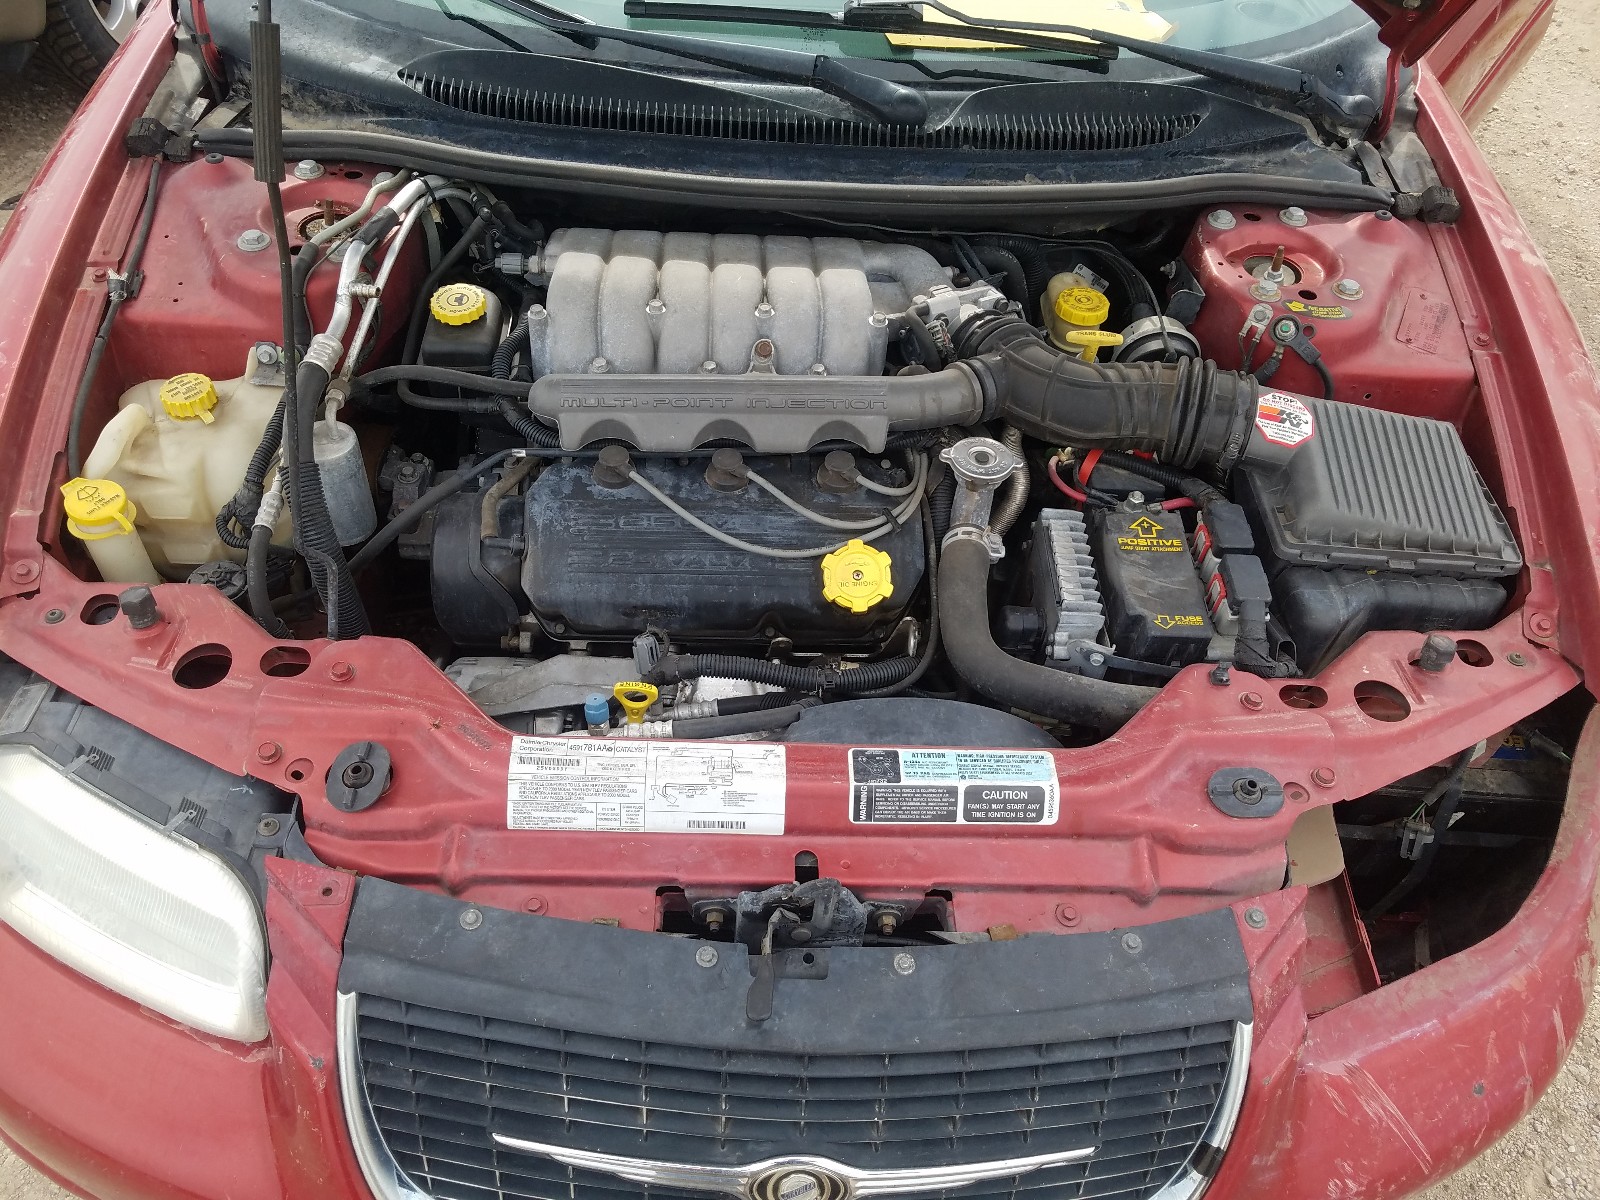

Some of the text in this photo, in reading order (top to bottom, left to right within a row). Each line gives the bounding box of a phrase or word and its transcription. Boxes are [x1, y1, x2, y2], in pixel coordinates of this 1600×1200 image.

[747, 397, 887, 410] INJECTION
[1118, 537, 1183, 546] POSITIVE
[519, 745, 554, 753] Corporation
[982, 790, 1028, 800] CAUTION
[860, 786, 868, 821] WARNING
